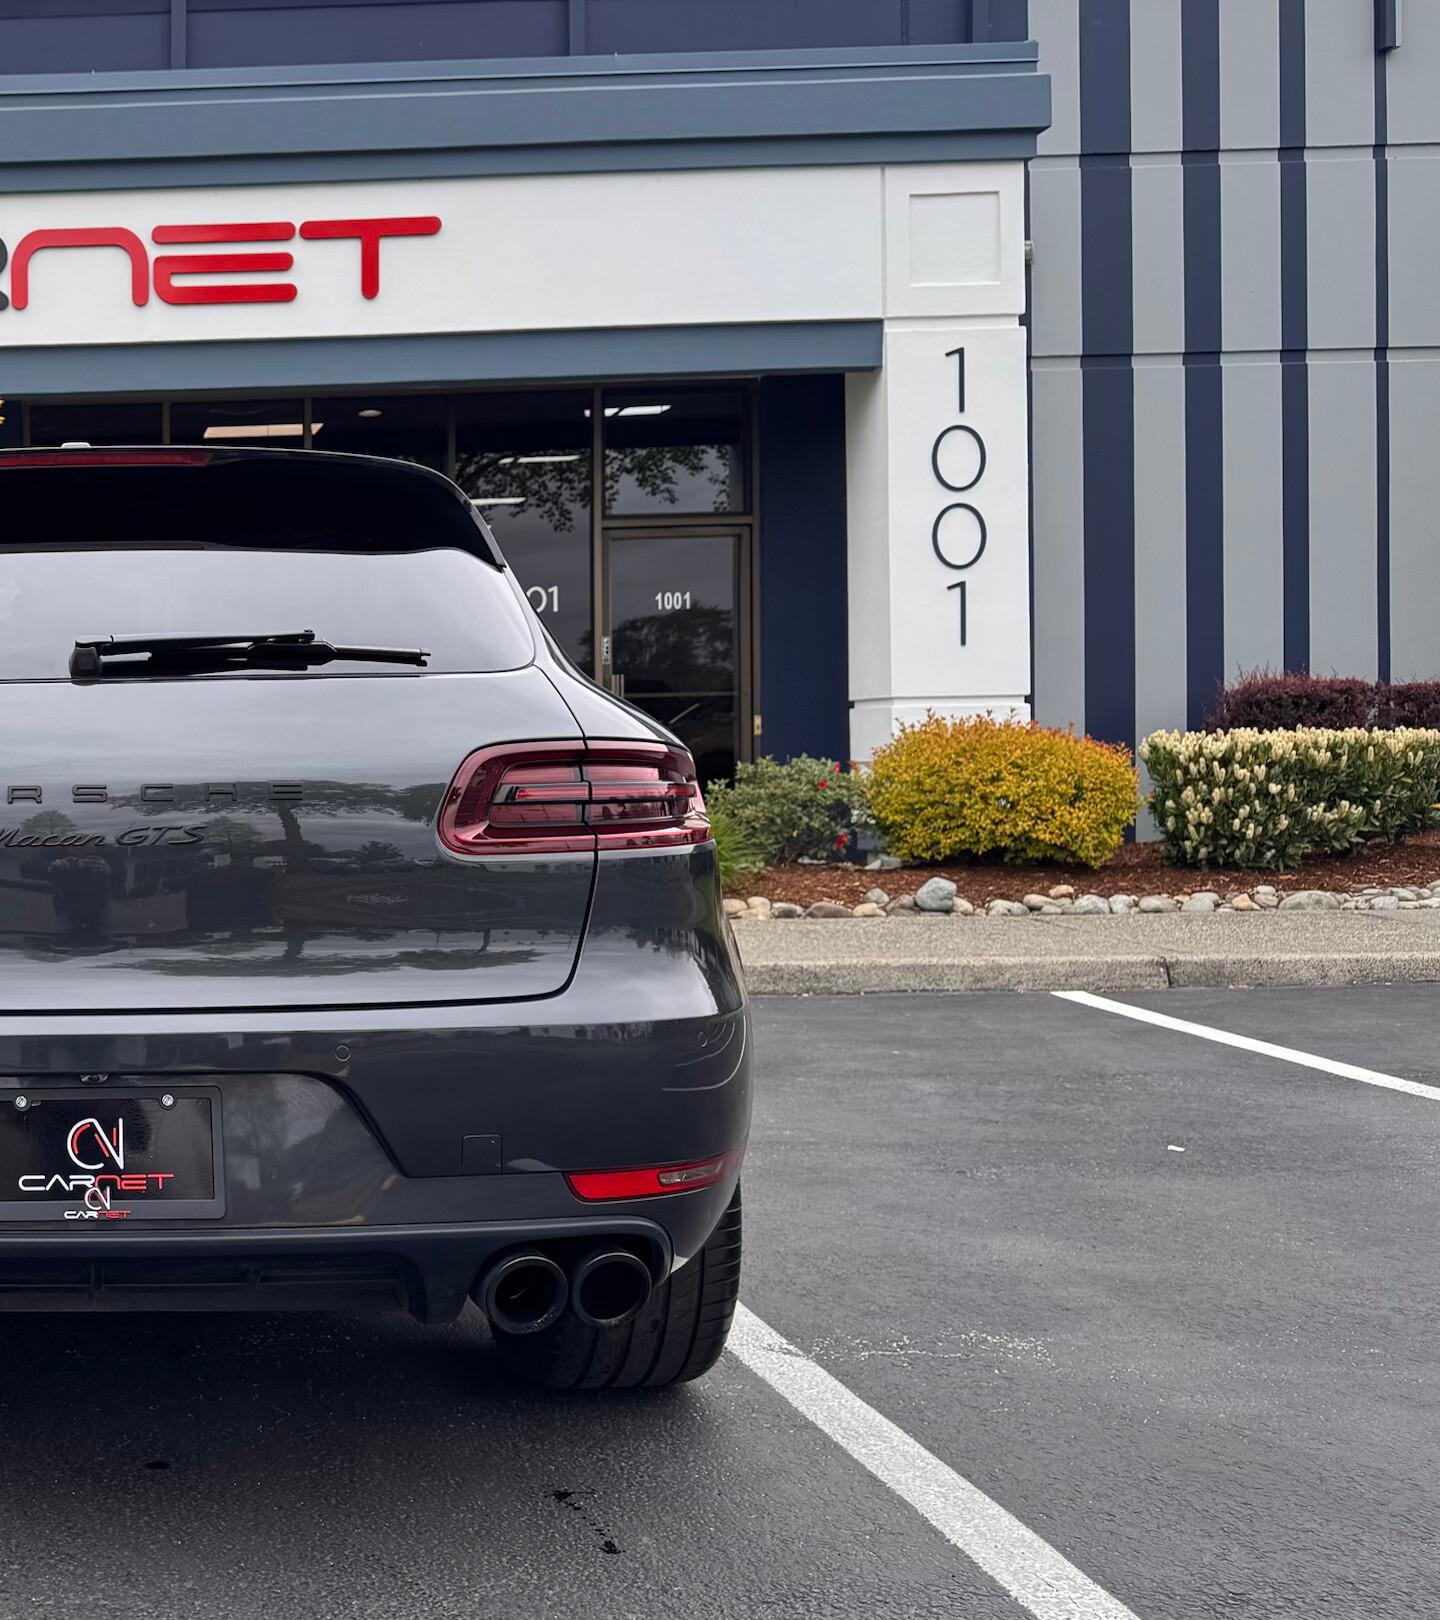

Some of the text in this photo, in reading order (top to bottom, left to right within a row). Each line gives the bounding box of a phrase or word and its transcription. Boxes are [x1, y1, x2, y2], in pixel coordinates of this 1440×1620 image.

[931, 347, 987, 647] 1001
[655, 591, 691, 610] 1001
[116, 824, 209, 846] GTS
[19, 1174, 174, 1191] CARNET
